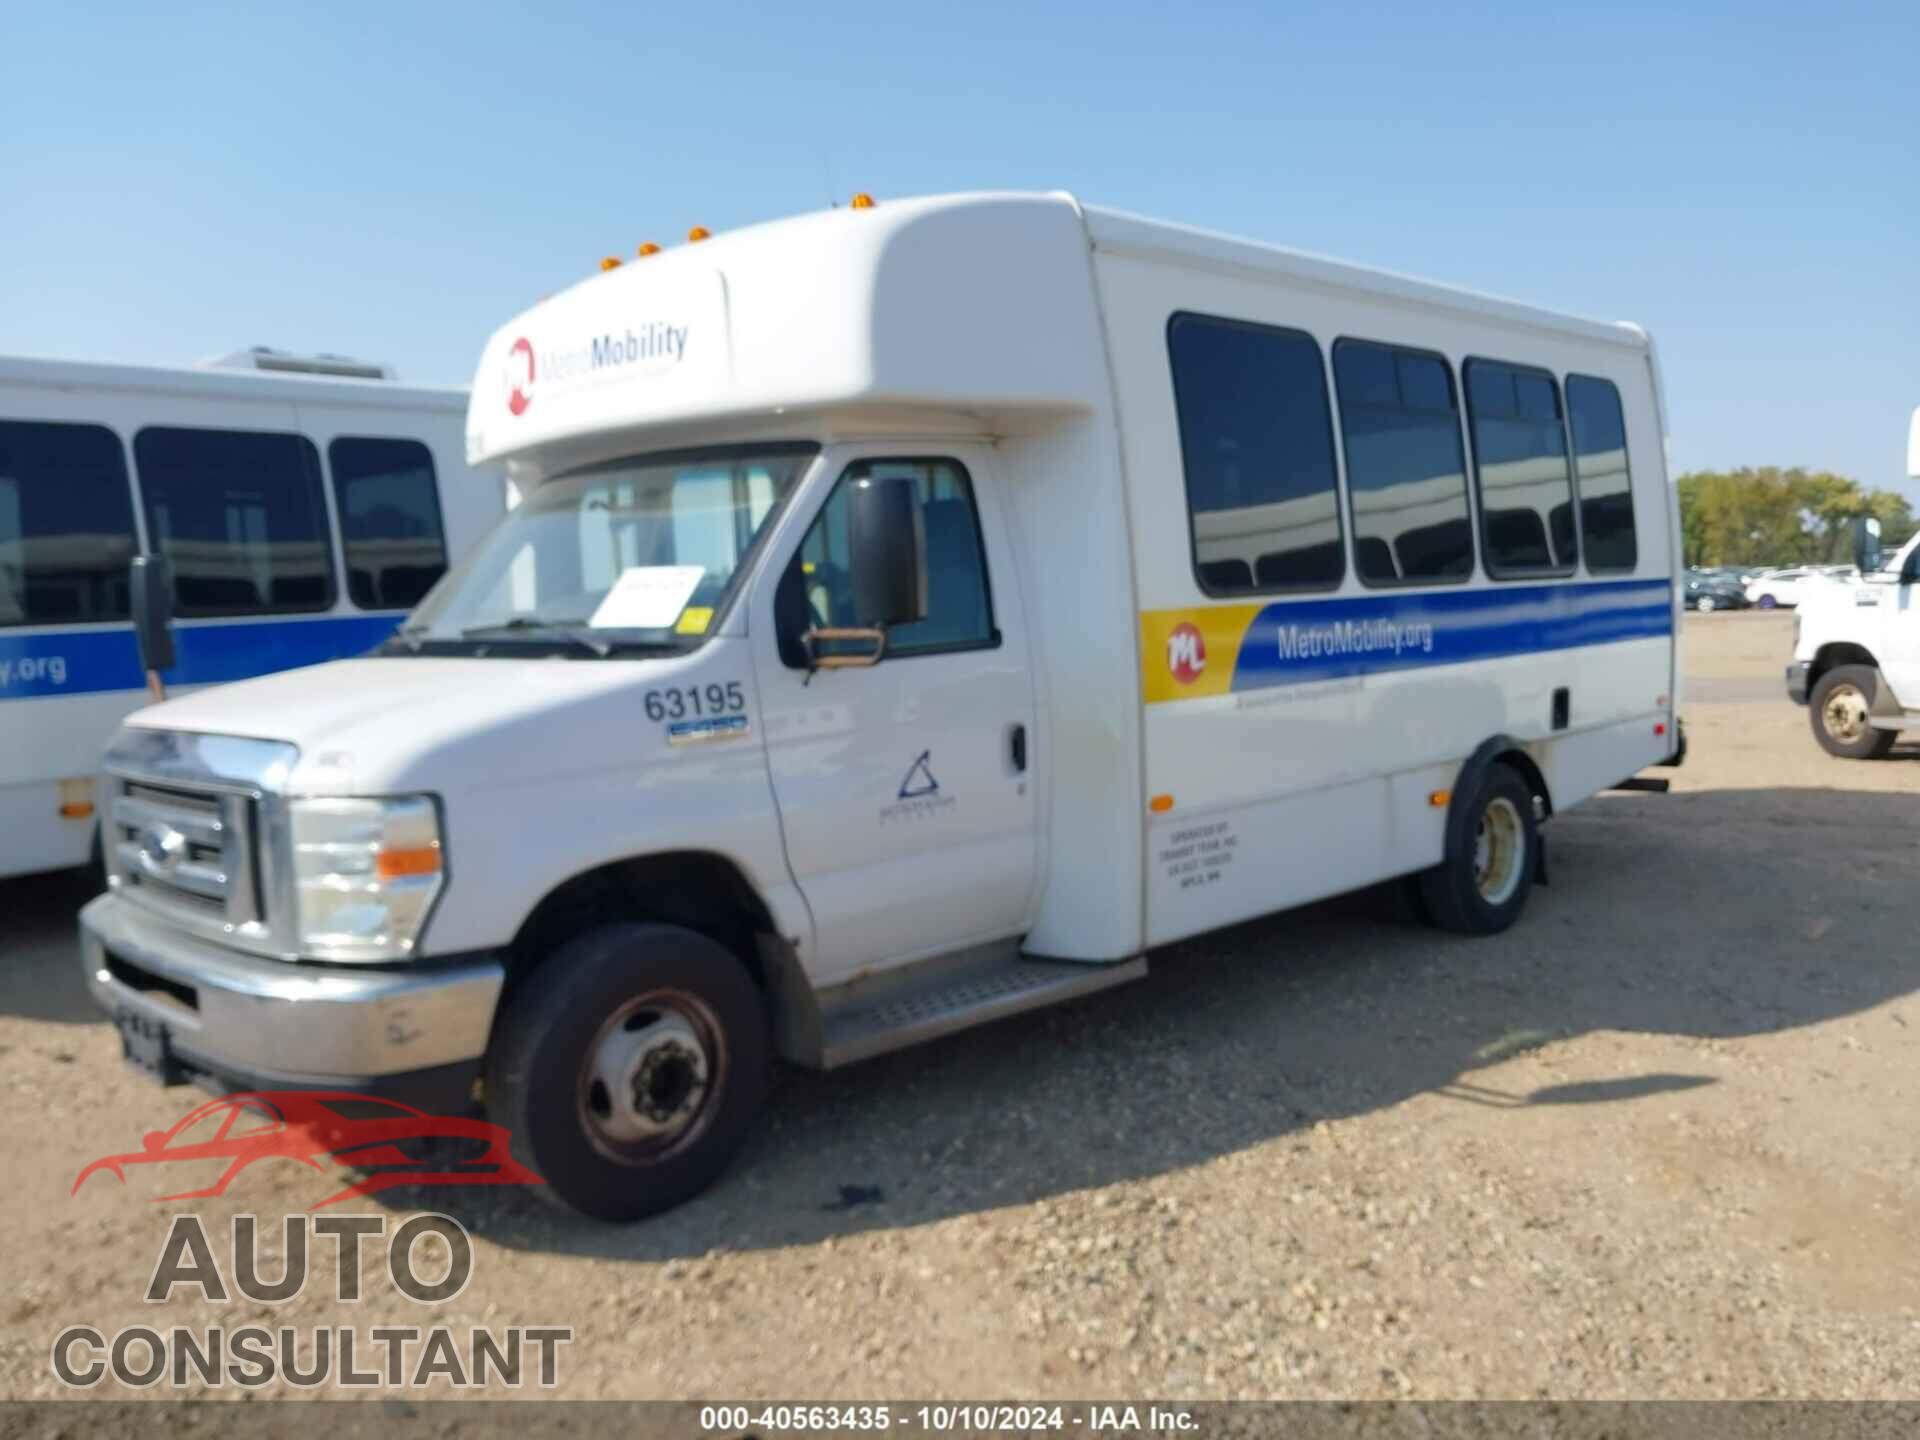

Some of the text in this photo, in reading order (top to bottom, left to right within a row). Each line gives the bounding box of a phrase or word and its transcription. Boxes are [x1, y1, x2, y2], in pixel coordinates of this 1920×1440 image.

[541, 321, 689, 384] MetMobility
[1277, 617, 1434, 661] MetroMobility.org
[643, 681, 746, 722] 63195
